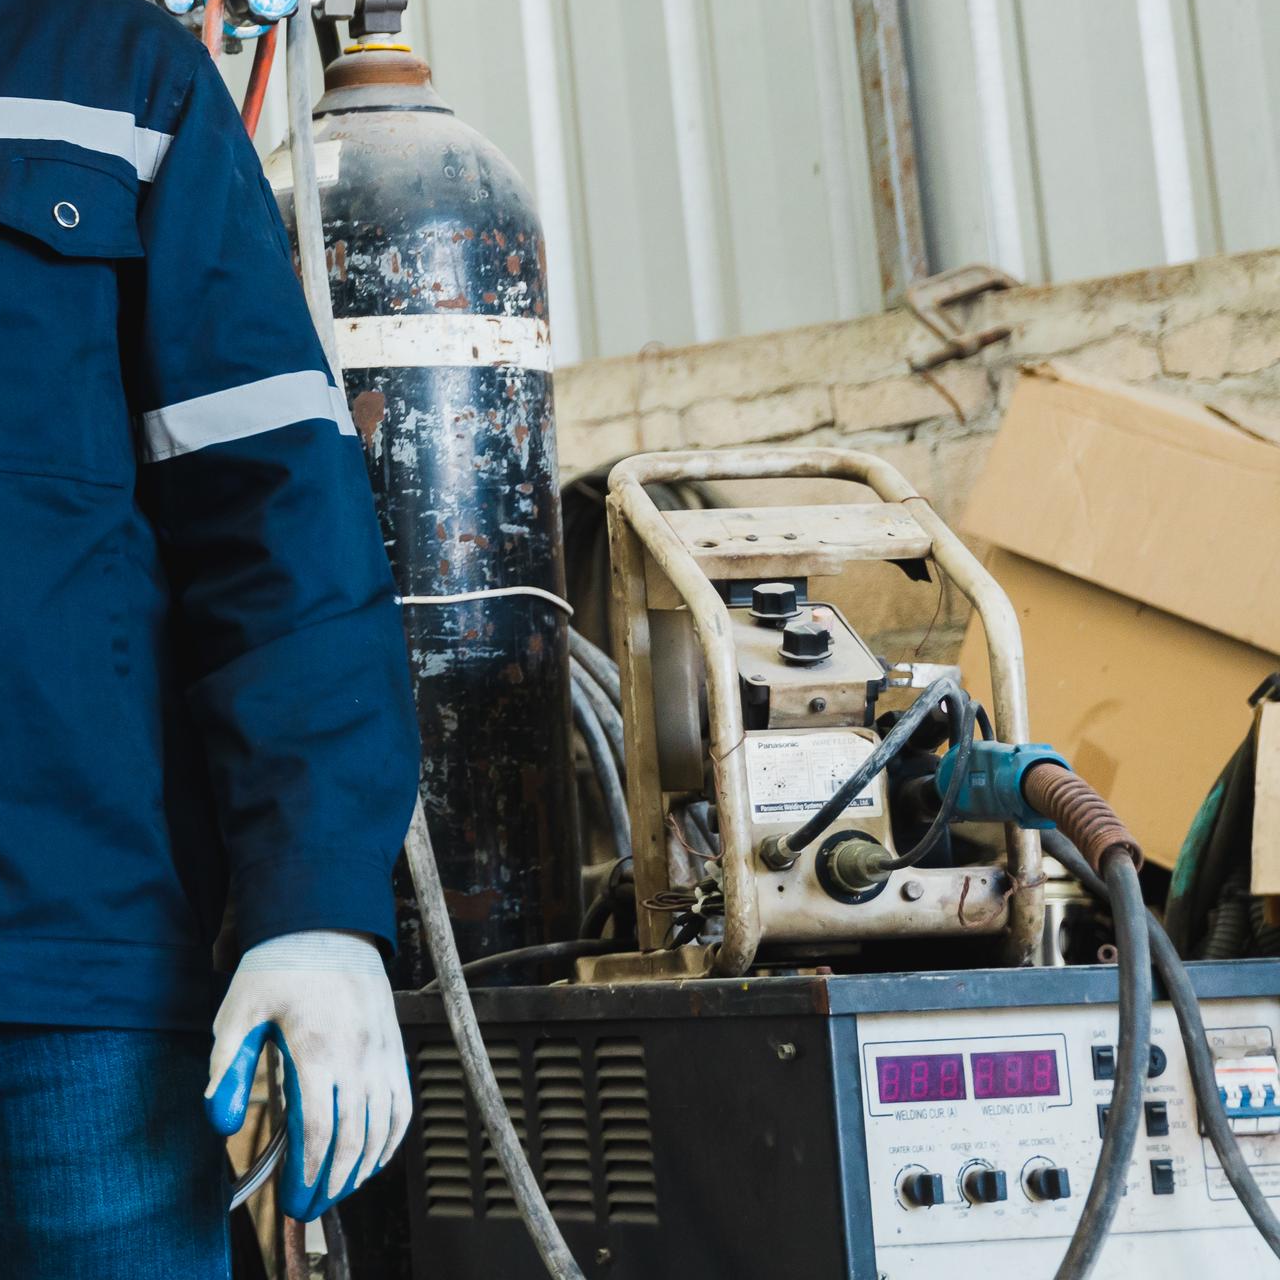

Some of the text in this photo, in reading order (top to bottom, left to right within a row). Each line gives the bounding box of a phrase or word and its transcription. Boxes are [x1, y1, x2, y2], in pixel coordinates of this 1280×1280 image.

[757, 740, 800, 750] Panasonic
[895, 1108, 928, 1121] WELDING
[981, 1103, 1014, 1116] WELDING
[1015, 1102, 1033, 1115] VOLT
